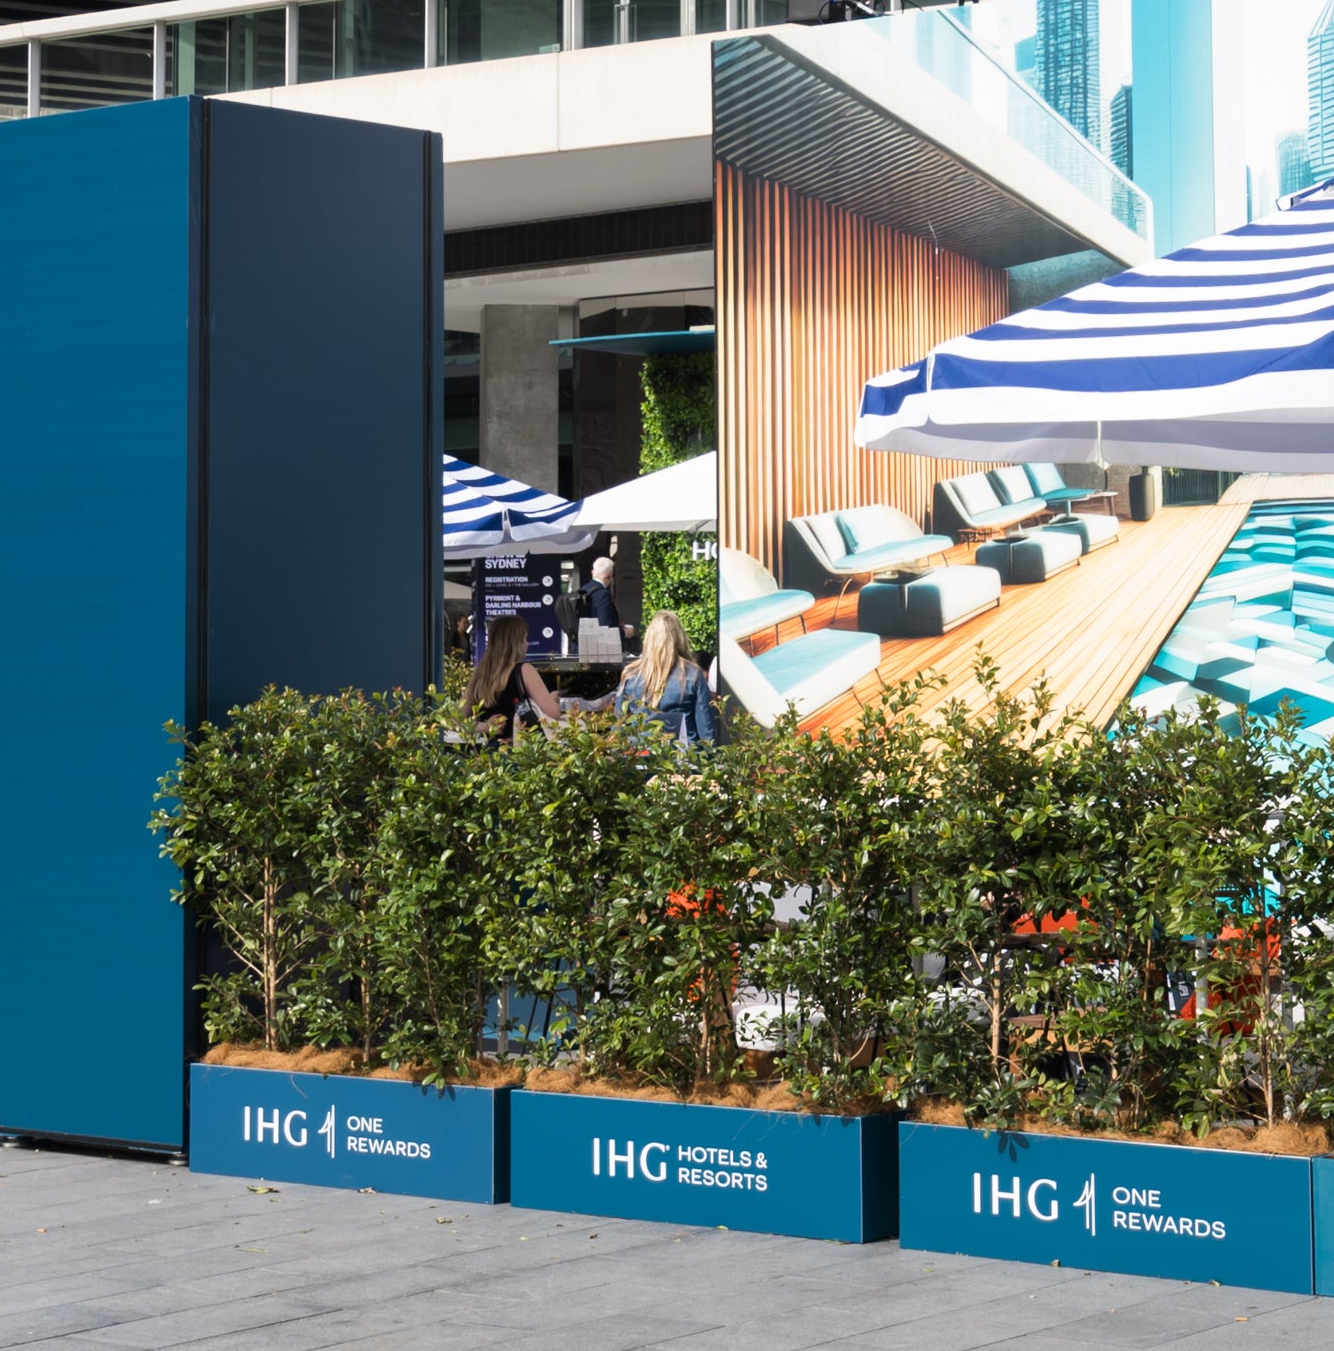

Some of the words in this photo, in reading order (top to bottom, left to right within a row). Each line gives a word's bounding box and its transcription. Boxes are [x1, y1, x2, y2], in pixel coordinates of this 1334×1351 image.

[484, 558, 527, 569] SYDNEY
[244, 1105, 308, 1147] IHG
[347, 1115, 383, 1134] ONE
[347, 1135, 432, 1160] REWARDS
[593, 1137, 670, 1182] IHG
[678, 1145, 753, 1168] HOTELS
[755, 1152, 768, 1169] &
[678, 1167, 769, 1192] RESORTS
[973, 1172, 1059, 1222] IHG
[1112, 1186, 1162, 1208] ONE
[1113, 1210, 1227, 1239] REWARDS
